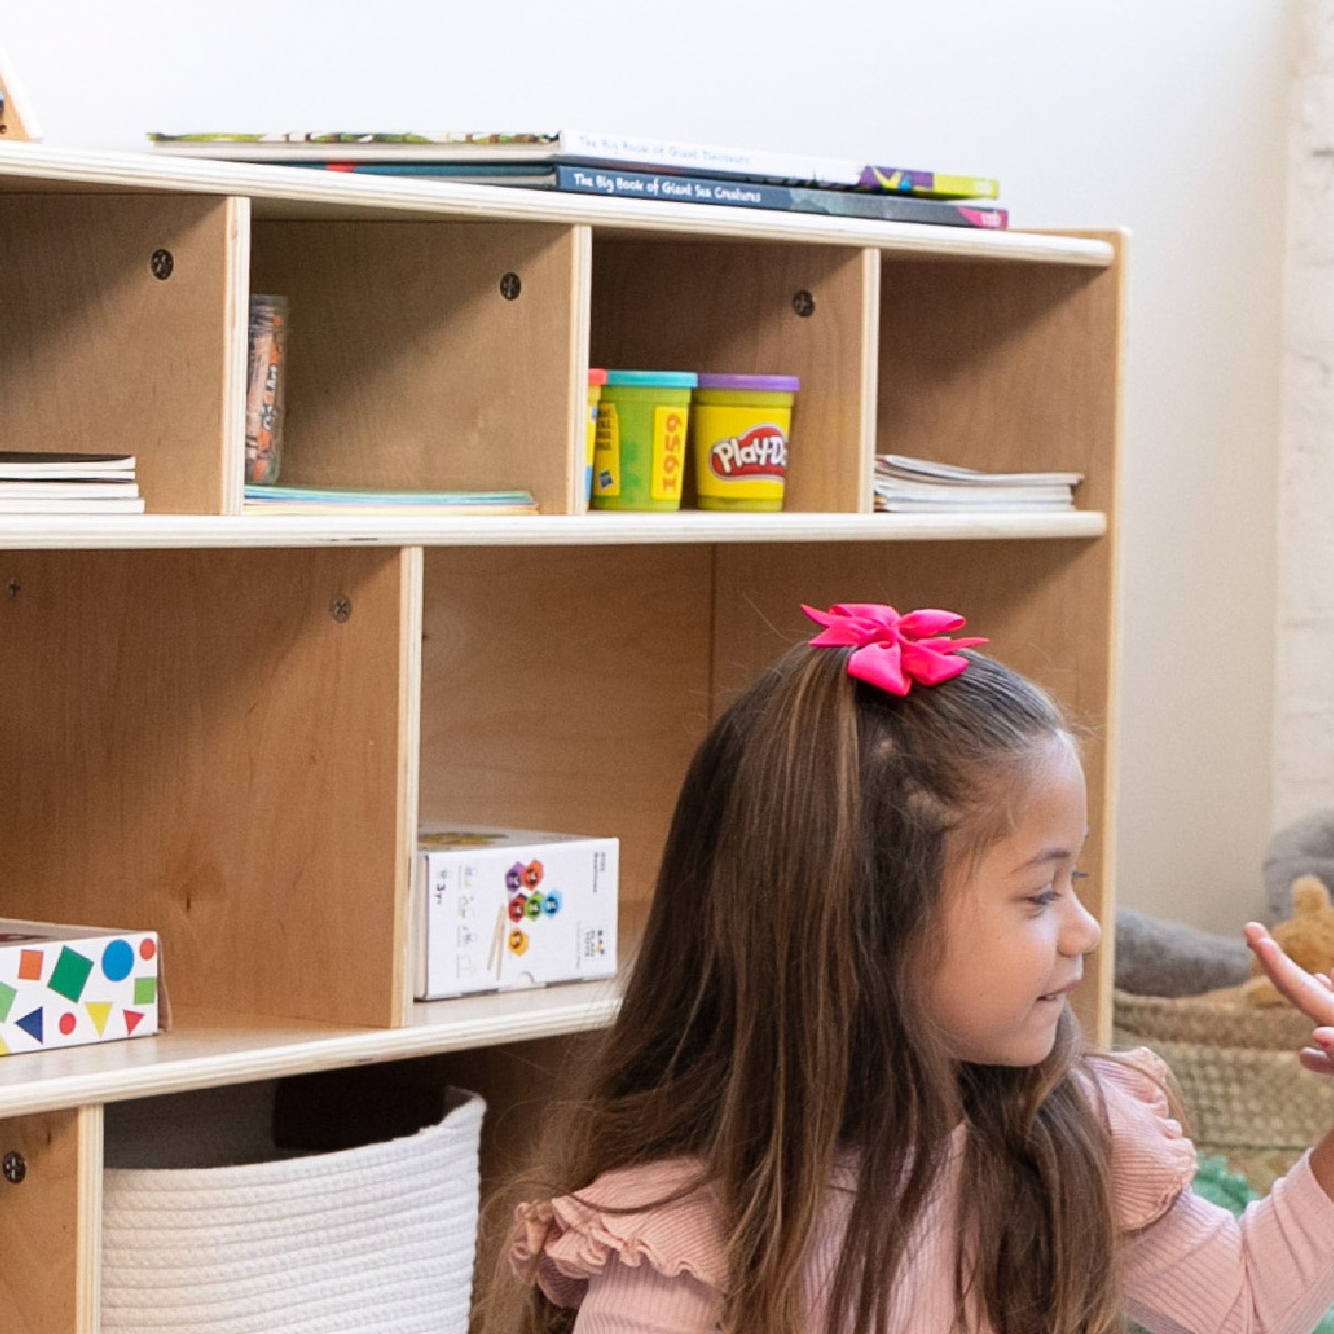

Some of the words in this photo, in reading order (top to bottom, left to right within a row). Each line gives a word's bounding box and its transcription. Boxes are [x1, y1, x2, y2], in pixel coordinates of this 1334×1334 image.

[573, 173, 593, 187] The
[596, 174, 614, 194] Big
[616, 176, 644, 191] Book
[646, 177, 659, 196] of
[662, 180, 693, 197] Giant
[694, 183, 712, 198] Sea
[714, 186, 762, 203] Creatures
[661, 414, 682, 483] 1959
[713, 435, 787, 474] Play-D
